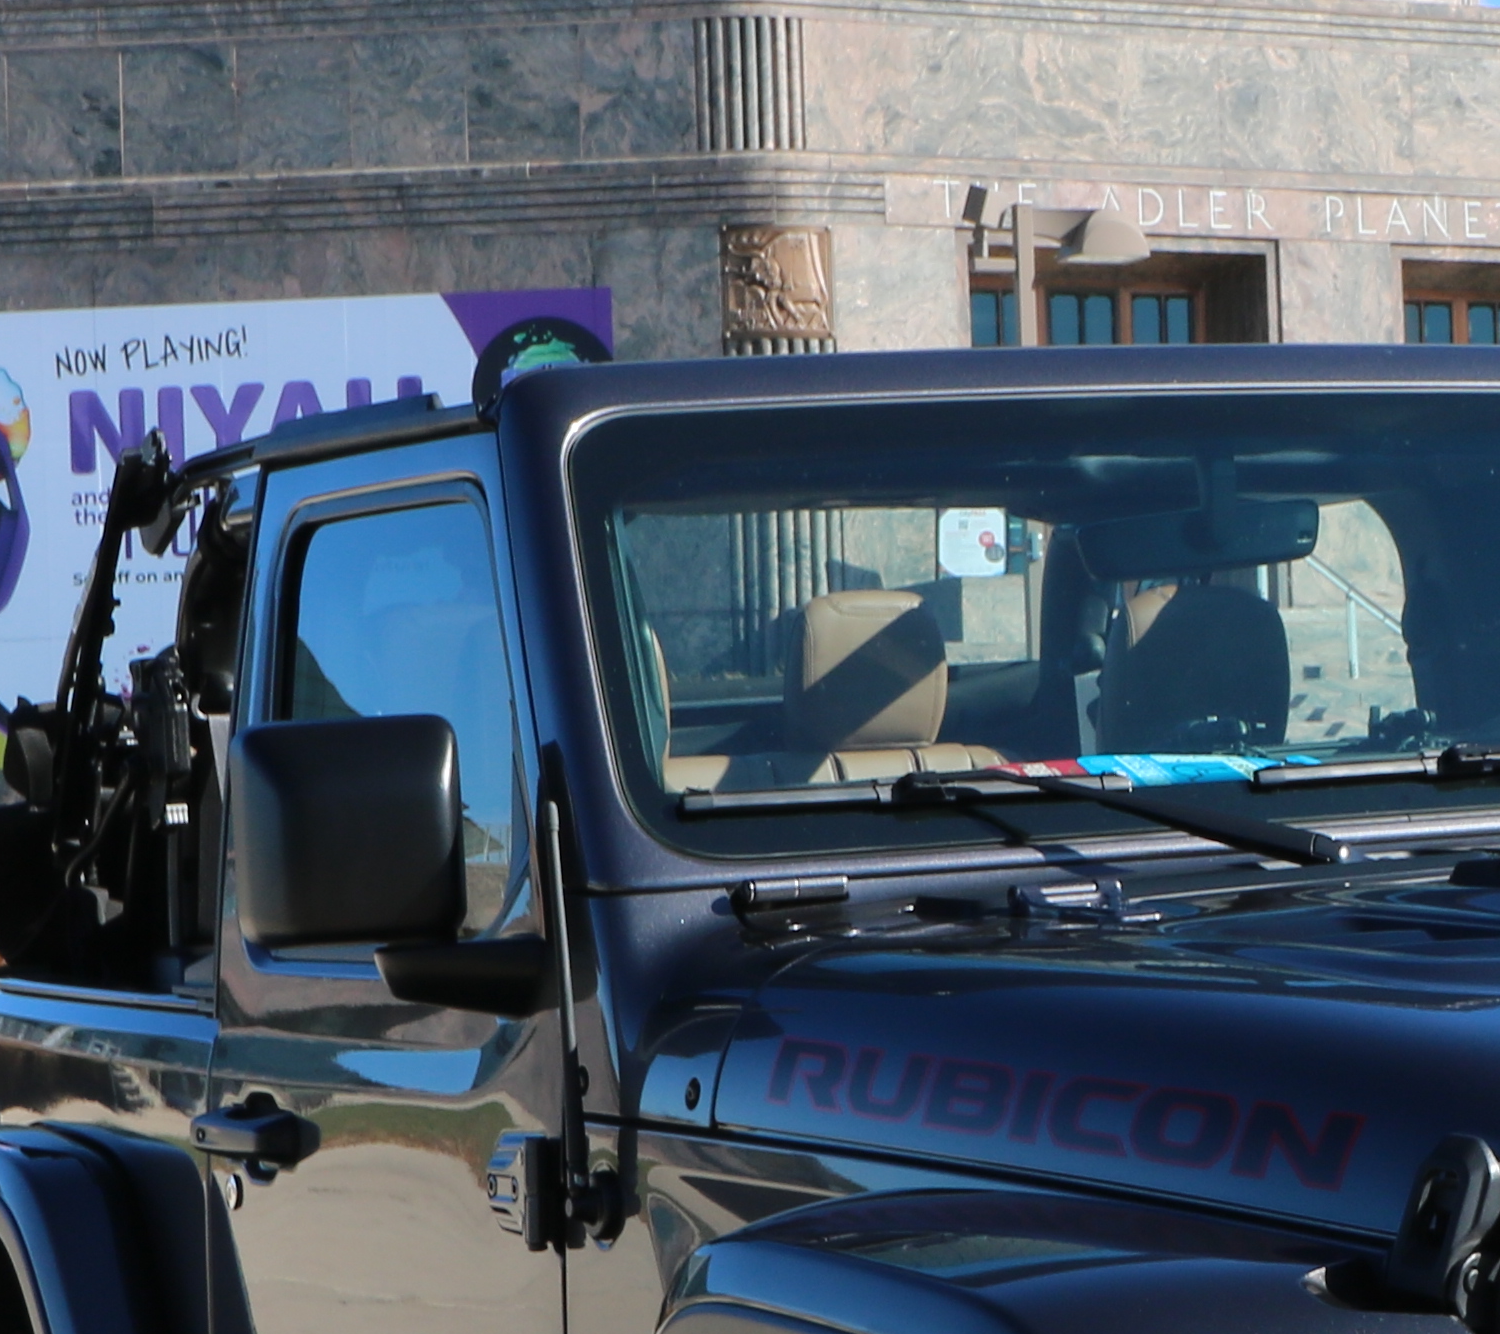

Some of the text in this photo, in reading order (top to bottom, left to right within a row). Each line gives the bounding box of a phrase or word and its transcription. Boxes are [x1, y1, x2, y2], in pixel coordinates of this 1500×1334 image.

[933, 179, 1038, 218] TE
[55, 324, 249, 379] NOW PLAYING!
[136, 571, 158, 584] on
[764, 1035, 1369, 1192] RUBICON
